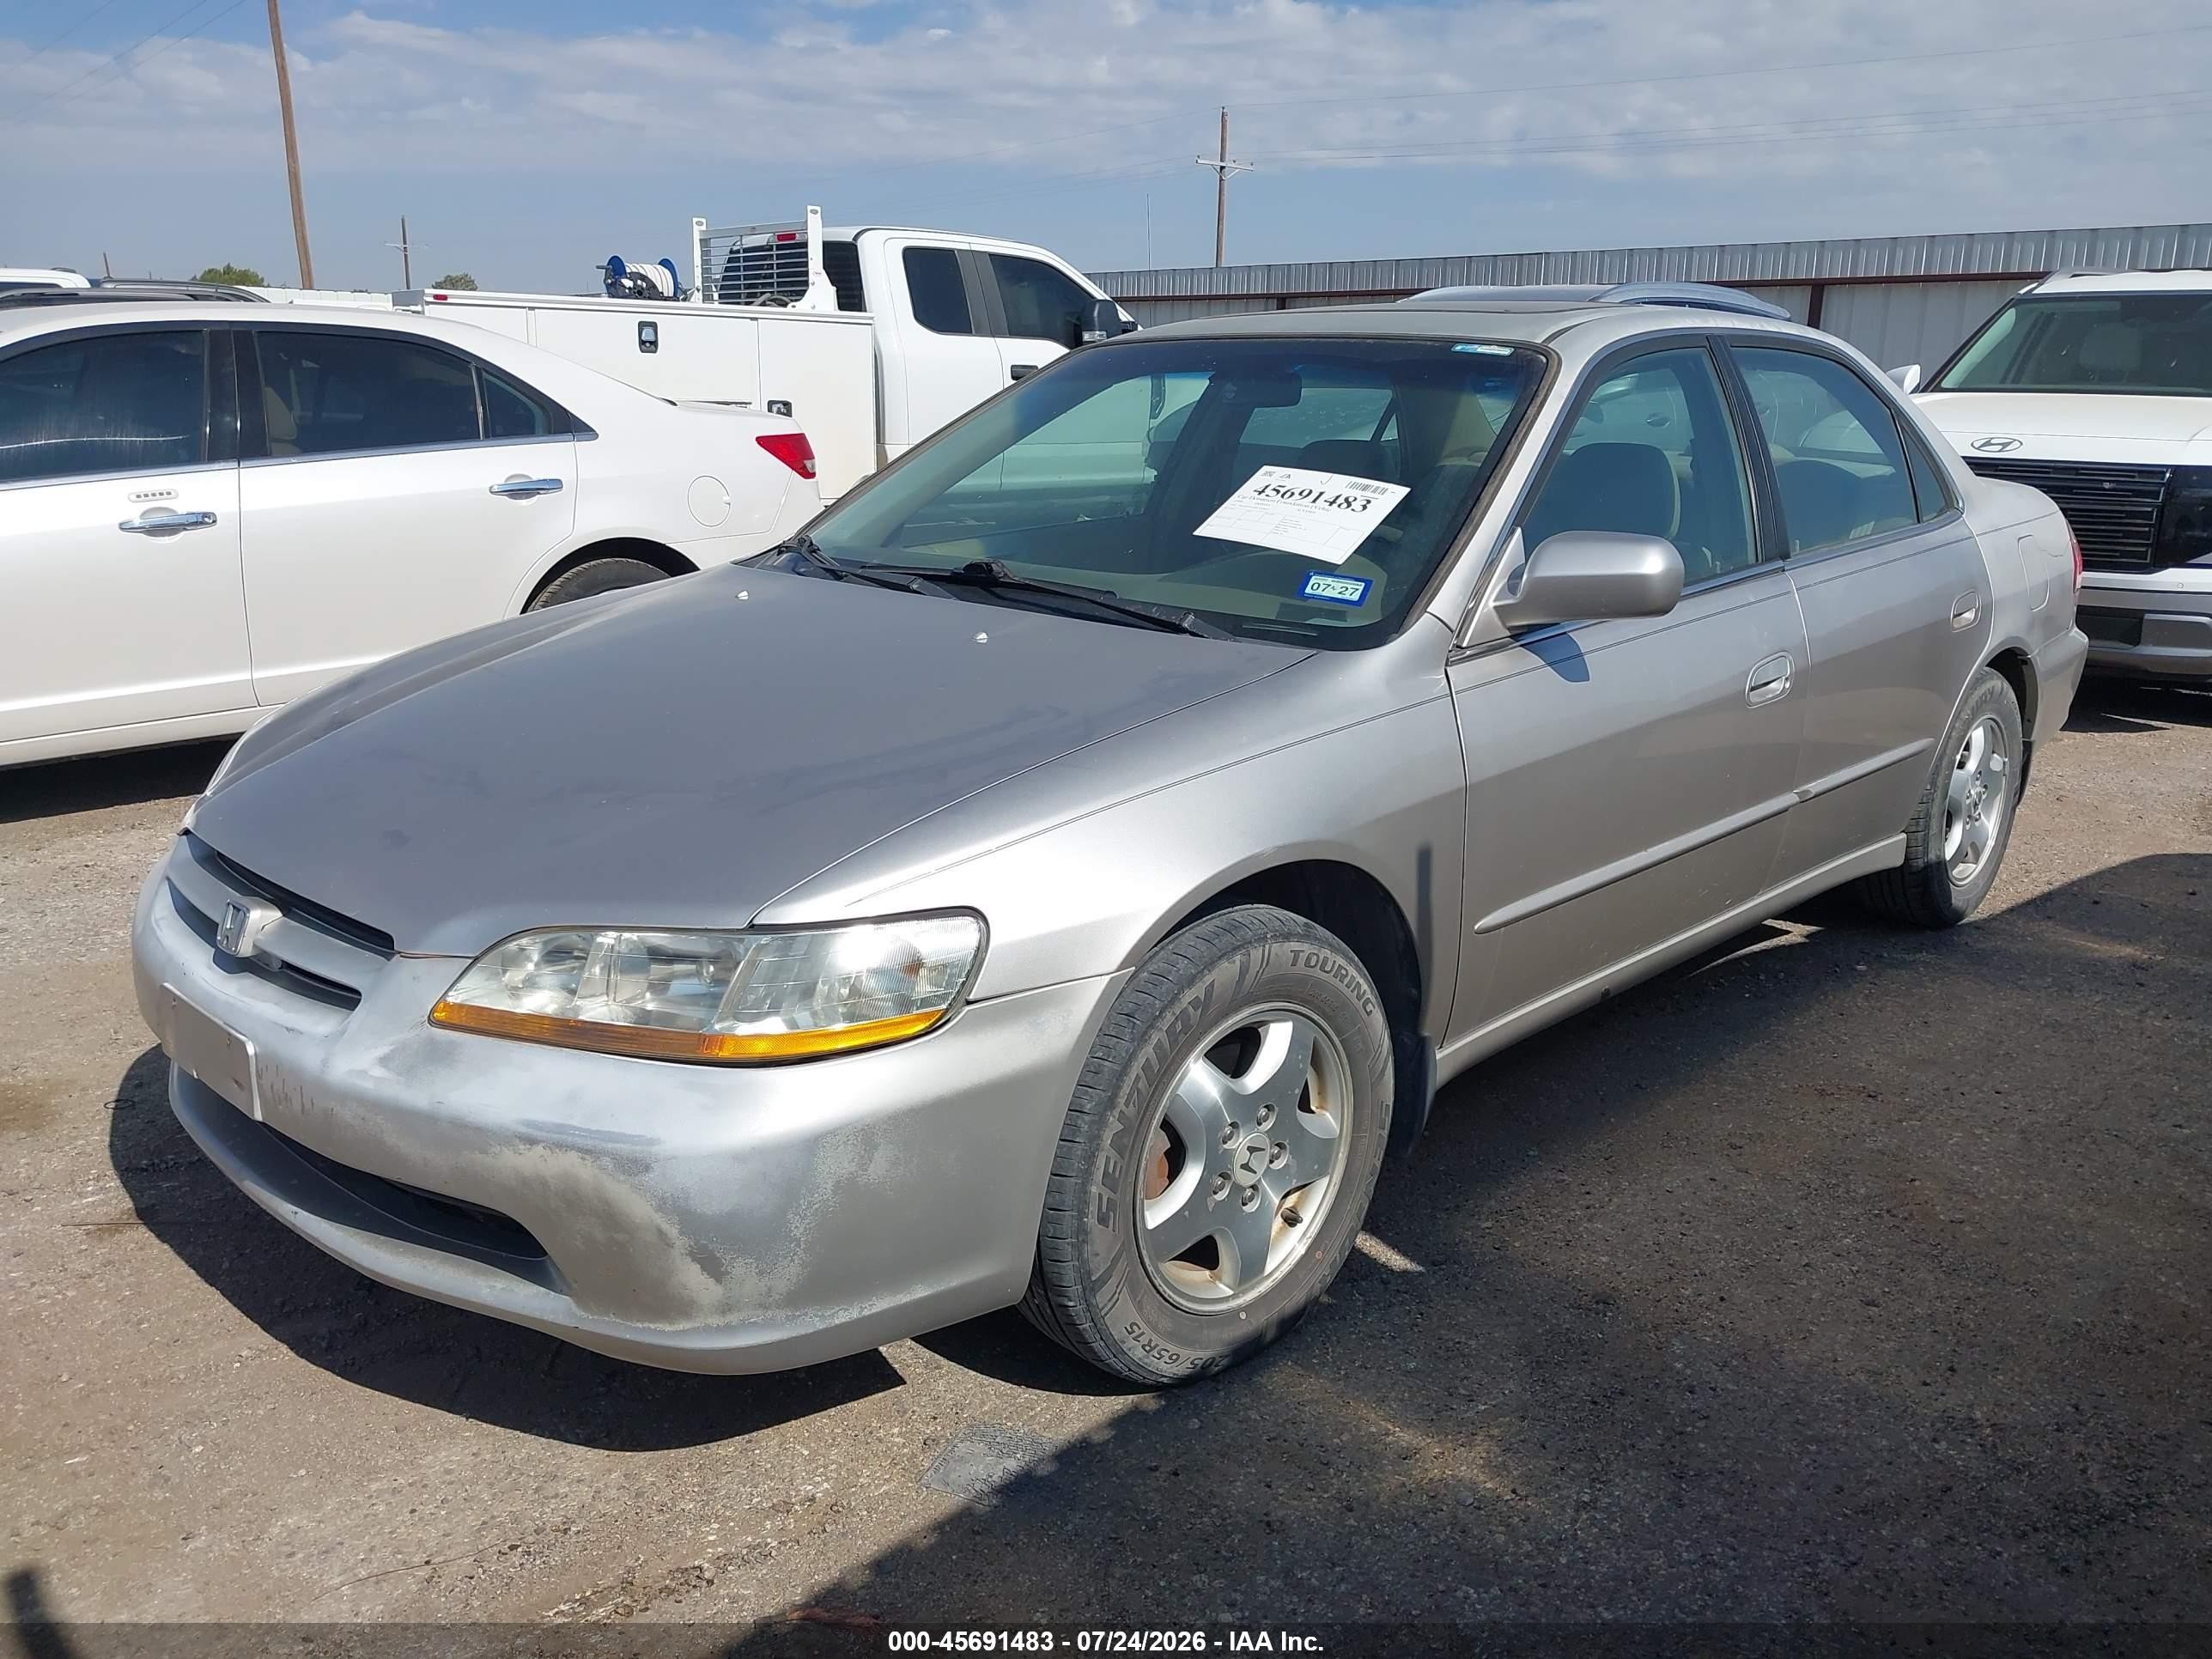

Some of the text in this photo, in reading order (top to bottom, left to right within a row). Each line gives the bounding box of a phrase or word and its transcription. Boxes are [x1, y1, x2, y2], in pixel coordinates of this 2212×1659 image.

[1253, 483, 1371, 513] 45691483
[1290, 949, 1376, 1017] TOURING
[1097, 978, 1216, 1234] SENTURY
[1124, 1322, 1231, 1370] 205/65R15
